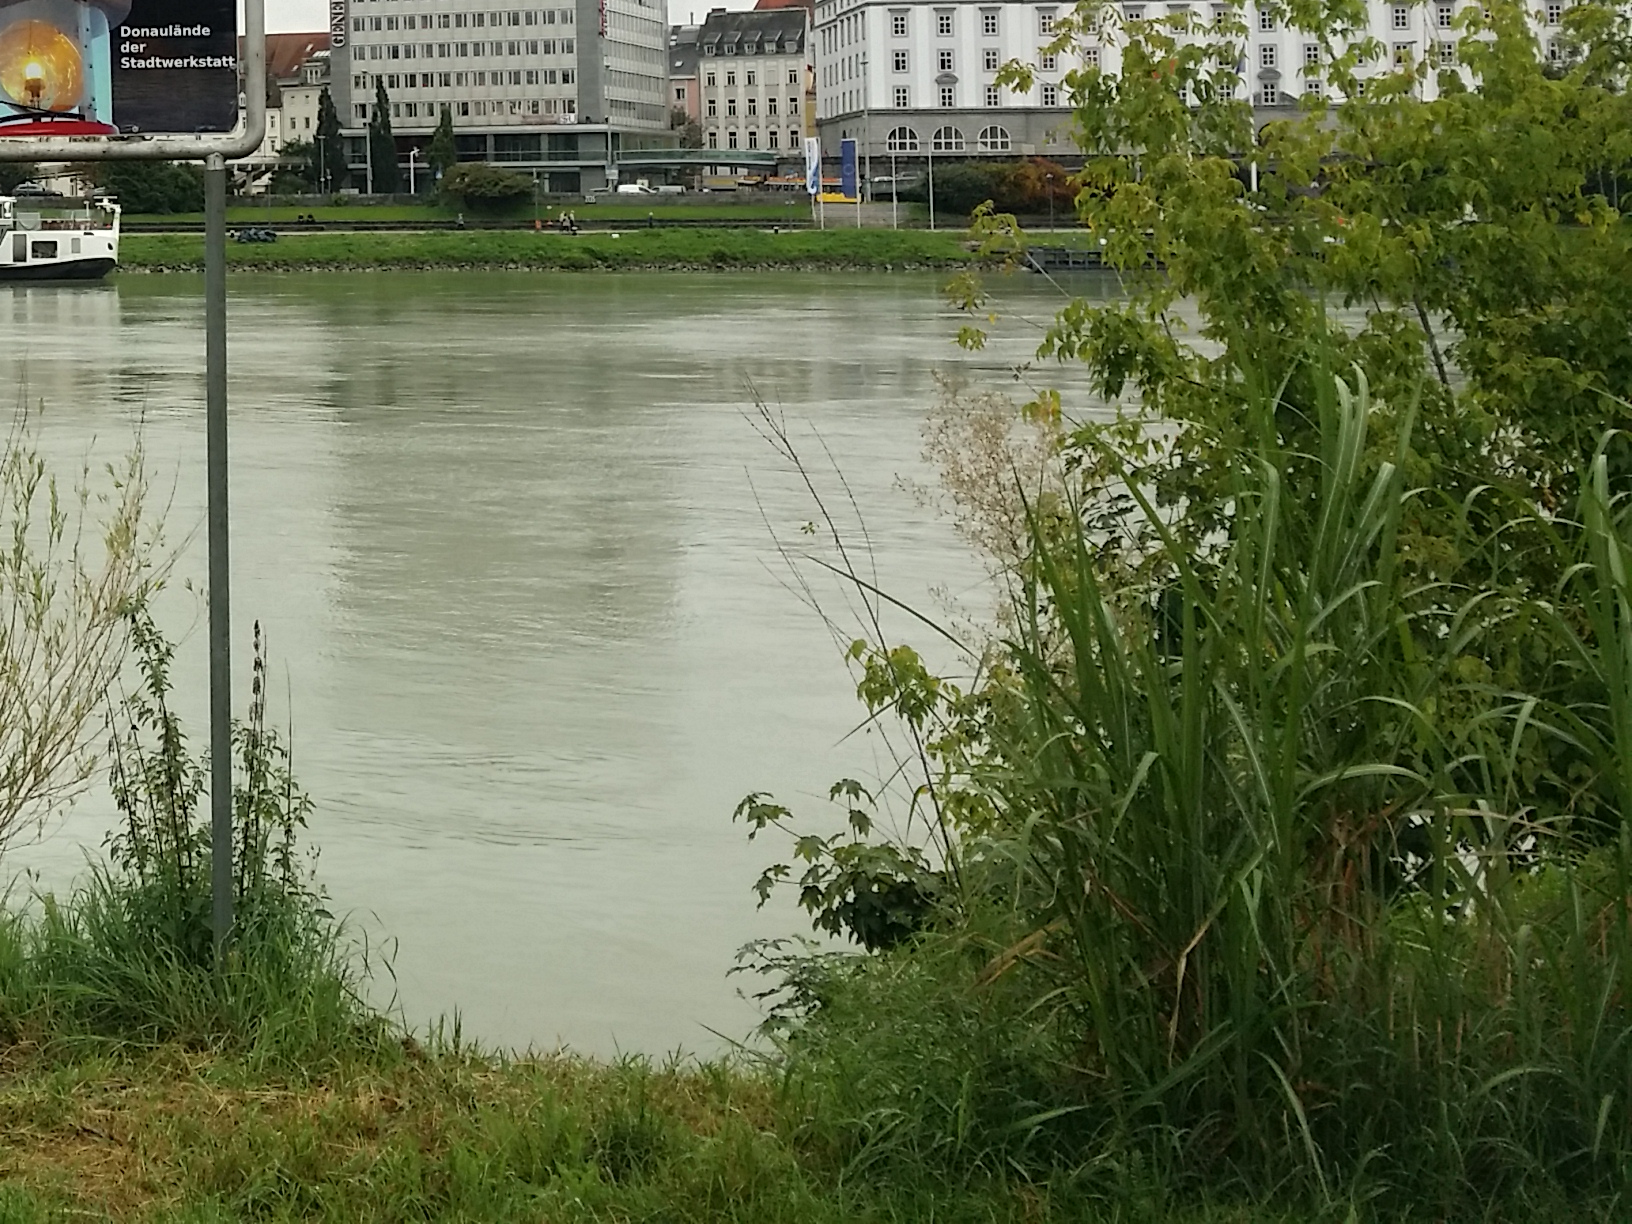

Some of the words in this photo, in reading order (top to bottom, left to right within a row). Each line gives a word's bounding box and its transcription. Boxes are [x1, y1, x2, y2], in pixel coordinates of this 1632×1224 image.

[120, 24, 211, 37] Donaulände
[120, 41, 147, 53] der
[120, 55, 236, 69] Stadtwerkstatt
